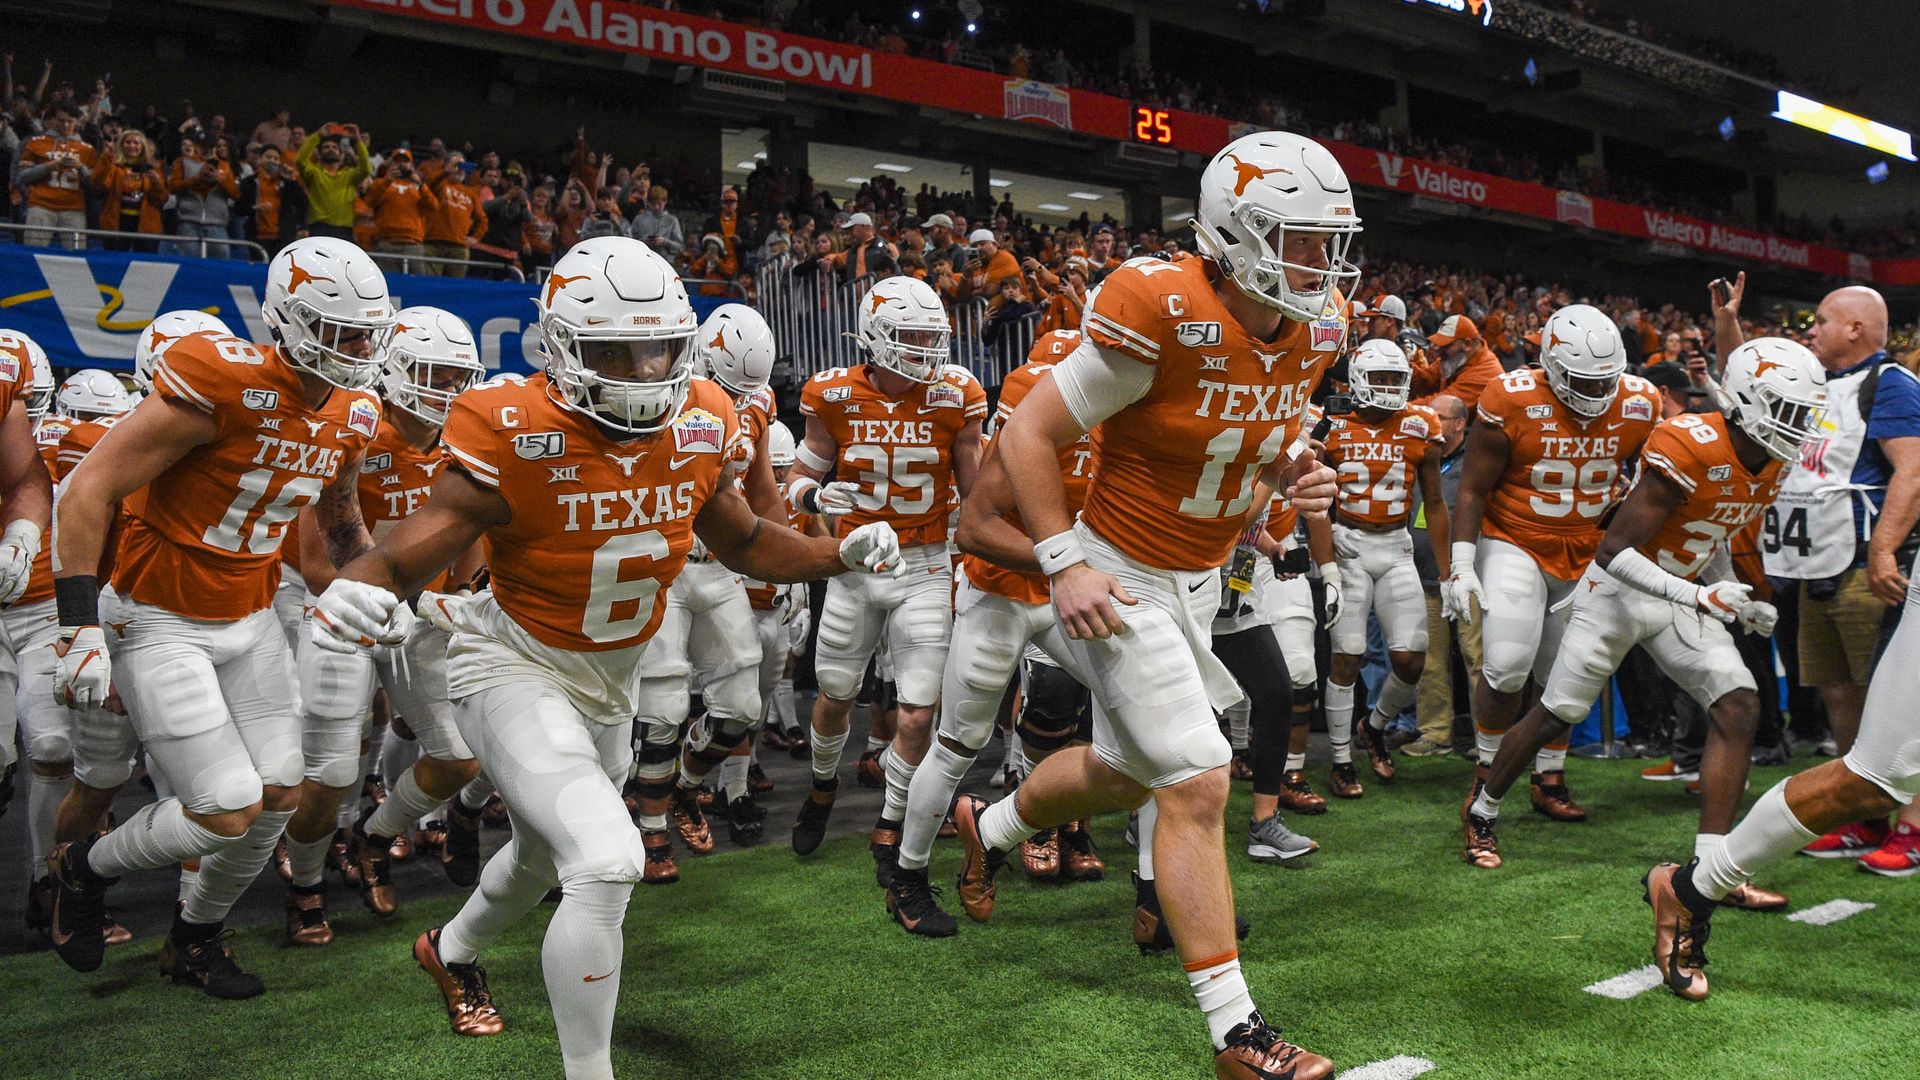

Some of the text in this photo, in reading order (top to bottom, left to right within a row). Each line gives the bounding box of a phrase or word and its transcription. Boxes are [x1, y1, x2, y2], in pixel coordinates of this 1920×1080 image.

[543, 0, 731, 63] Alamo
[745, 31, 873, 88] Bowl
[1137, 107, 1171, 143] 25
[1412, 164, 1485, 201] Valero
[1645, 210, 1809, 266] Valero Alamo Bowl
[633, 316, 661, 325] HORNS
[1167, 294, 1185, 317] C
[1052, 341, 1063, 354] C
[500, 406, 519, 428] C
[1195, 379, 1311, 421] TEXAS
[684, 420, 714, 429] Valero
[848, 420, 933, 443] TEXAS
[252, 433, 343, 478] TEXAS
[361, 453, 391, 473] 50
[1339, 443, 1405, 462] TEXAS
[1541, 436, 1620, 459] TEXAS
[843, 444, 940, 515] 35
[1178, 424, 1286, 518] 11
[1337, 461, 1407, 515] 24
[1529, 459, 1619, 518] 99
[202, 468, 324, 555] 18
[558, 481, 696, 532] TEXAS
[1764, 506, 1812, 557] 94
[582, 529, 670, 644] 6
